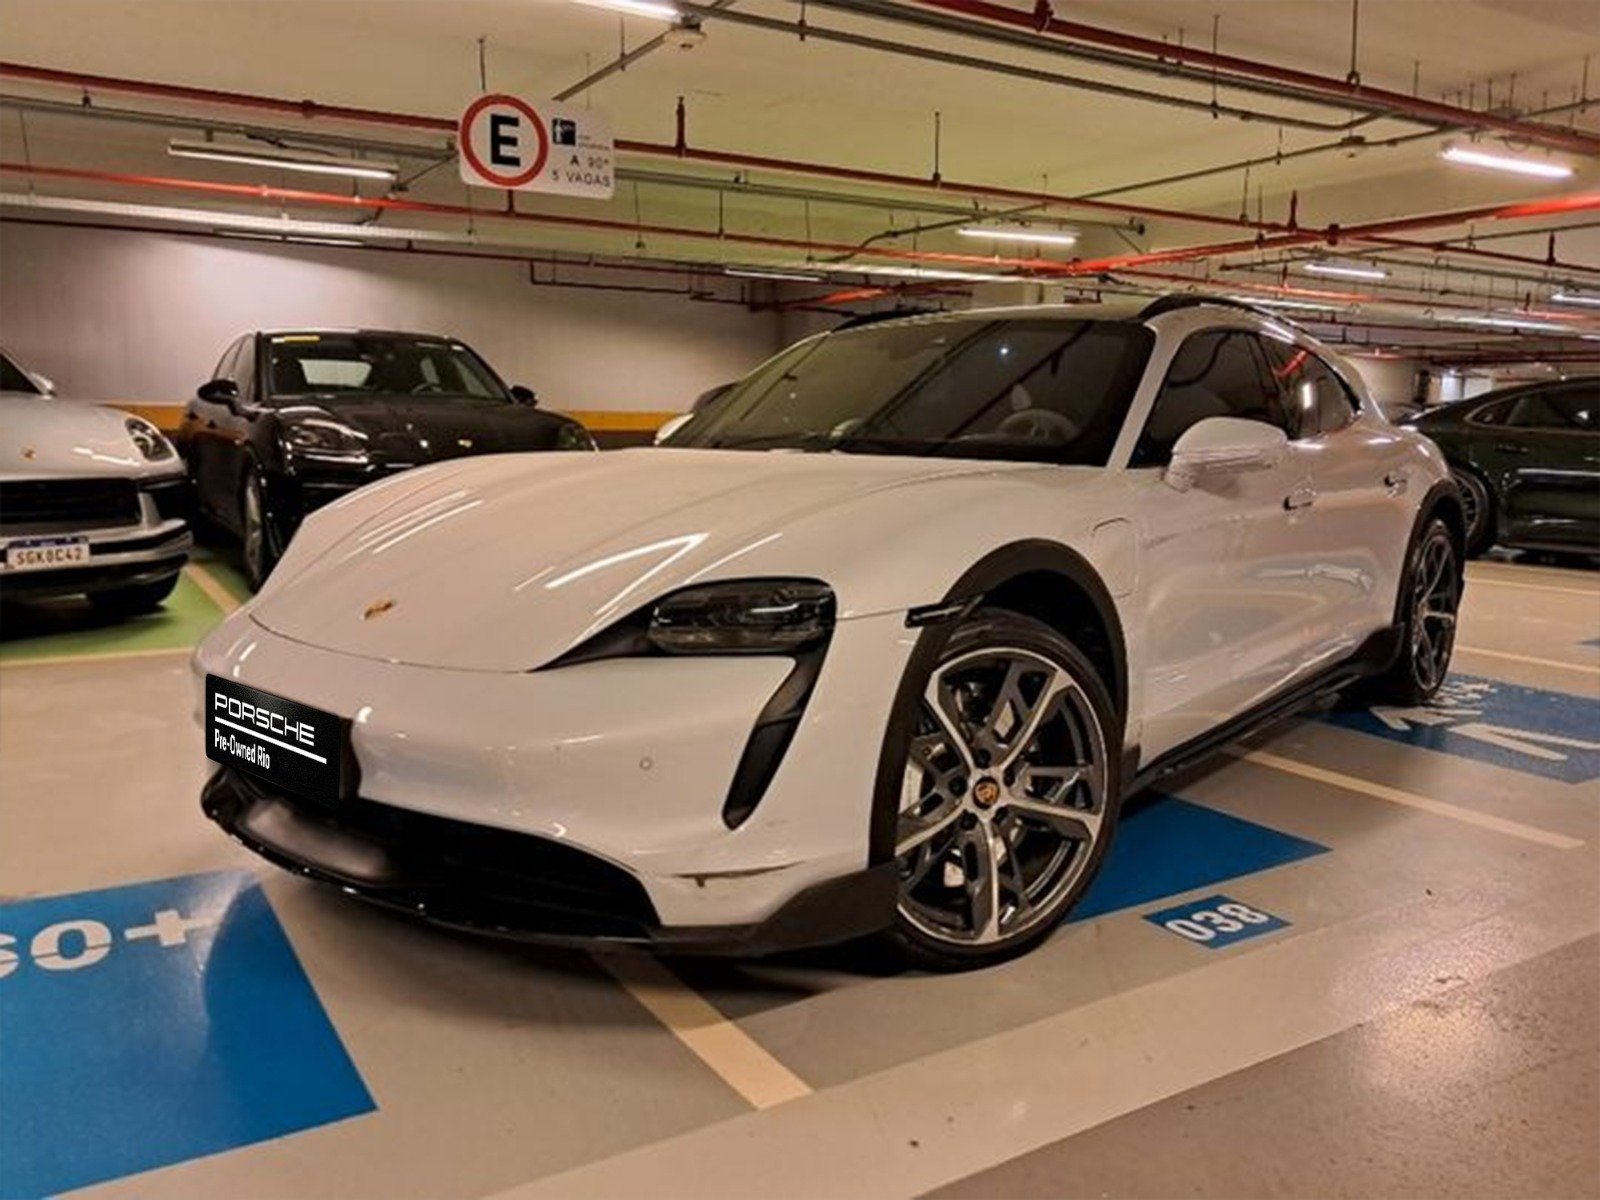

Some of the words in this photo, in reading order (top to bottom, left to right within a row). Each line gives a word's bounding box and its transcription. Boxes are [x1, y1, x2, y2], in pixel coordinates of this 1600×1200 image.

[491, 113, 520, 168] E
[570, 154, 579, 167] A
[214, 692, 315, 747] PORSCHE
[214, 728, 256, 764] Pre-Owned
[257, 745, 271, 770] Rio
[1165, 903, 1269, 941] 038
